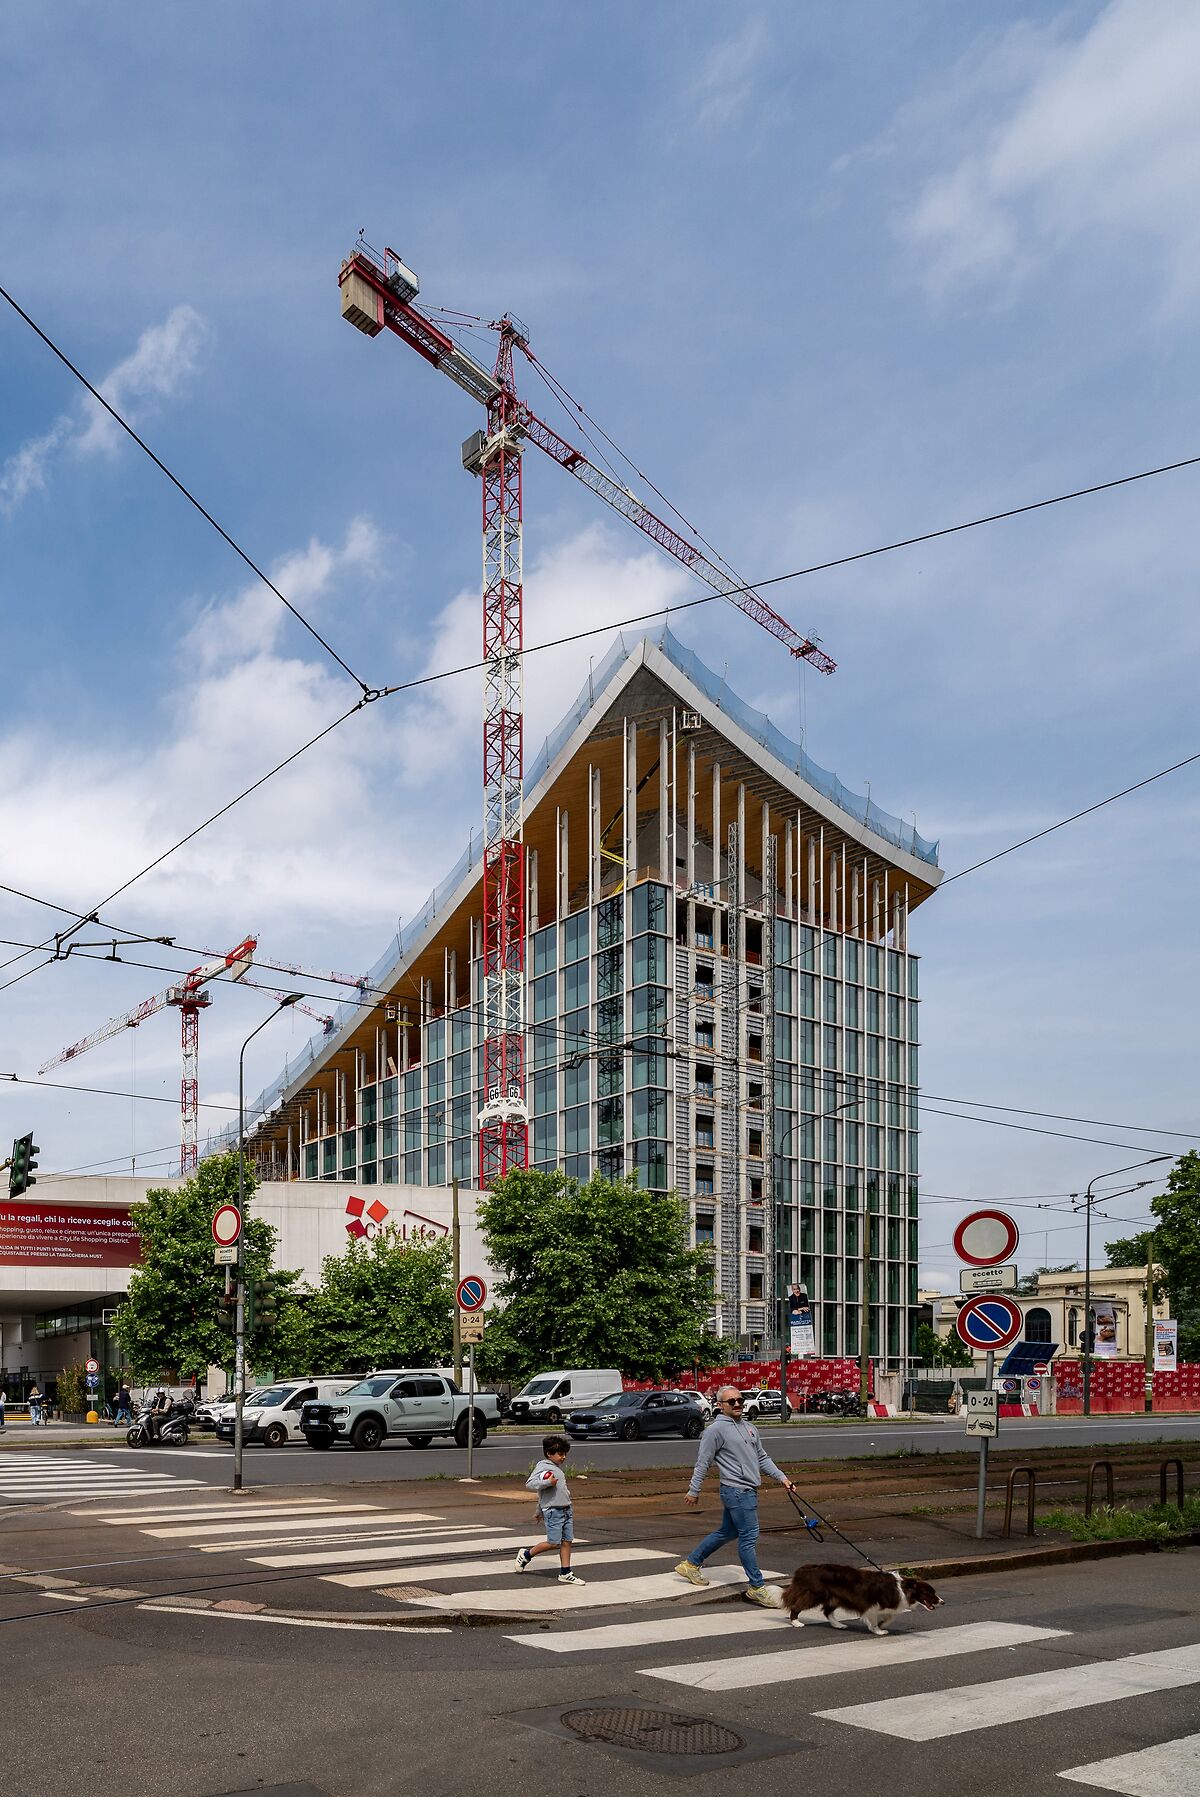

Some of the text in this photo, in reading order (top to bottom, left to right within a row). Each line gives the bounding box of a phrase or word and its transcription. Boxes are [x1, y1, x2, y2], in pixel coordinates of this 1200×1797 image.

[490, 1088, 499, 1100] G6
[510, 1087, 518, 1098] G6
[8, 1213, 15, 1221] la
[17, 1214, 43, 1223] regali,
[67, 1216, 91, 1224] riceve
[93, 1218, 120, 1227] sceglie
[59, 1235, 80, 1243] CityLife
[81, 1236, 108, 1244] Shopping
[972, 1269, 1003, 1277] eccetto
